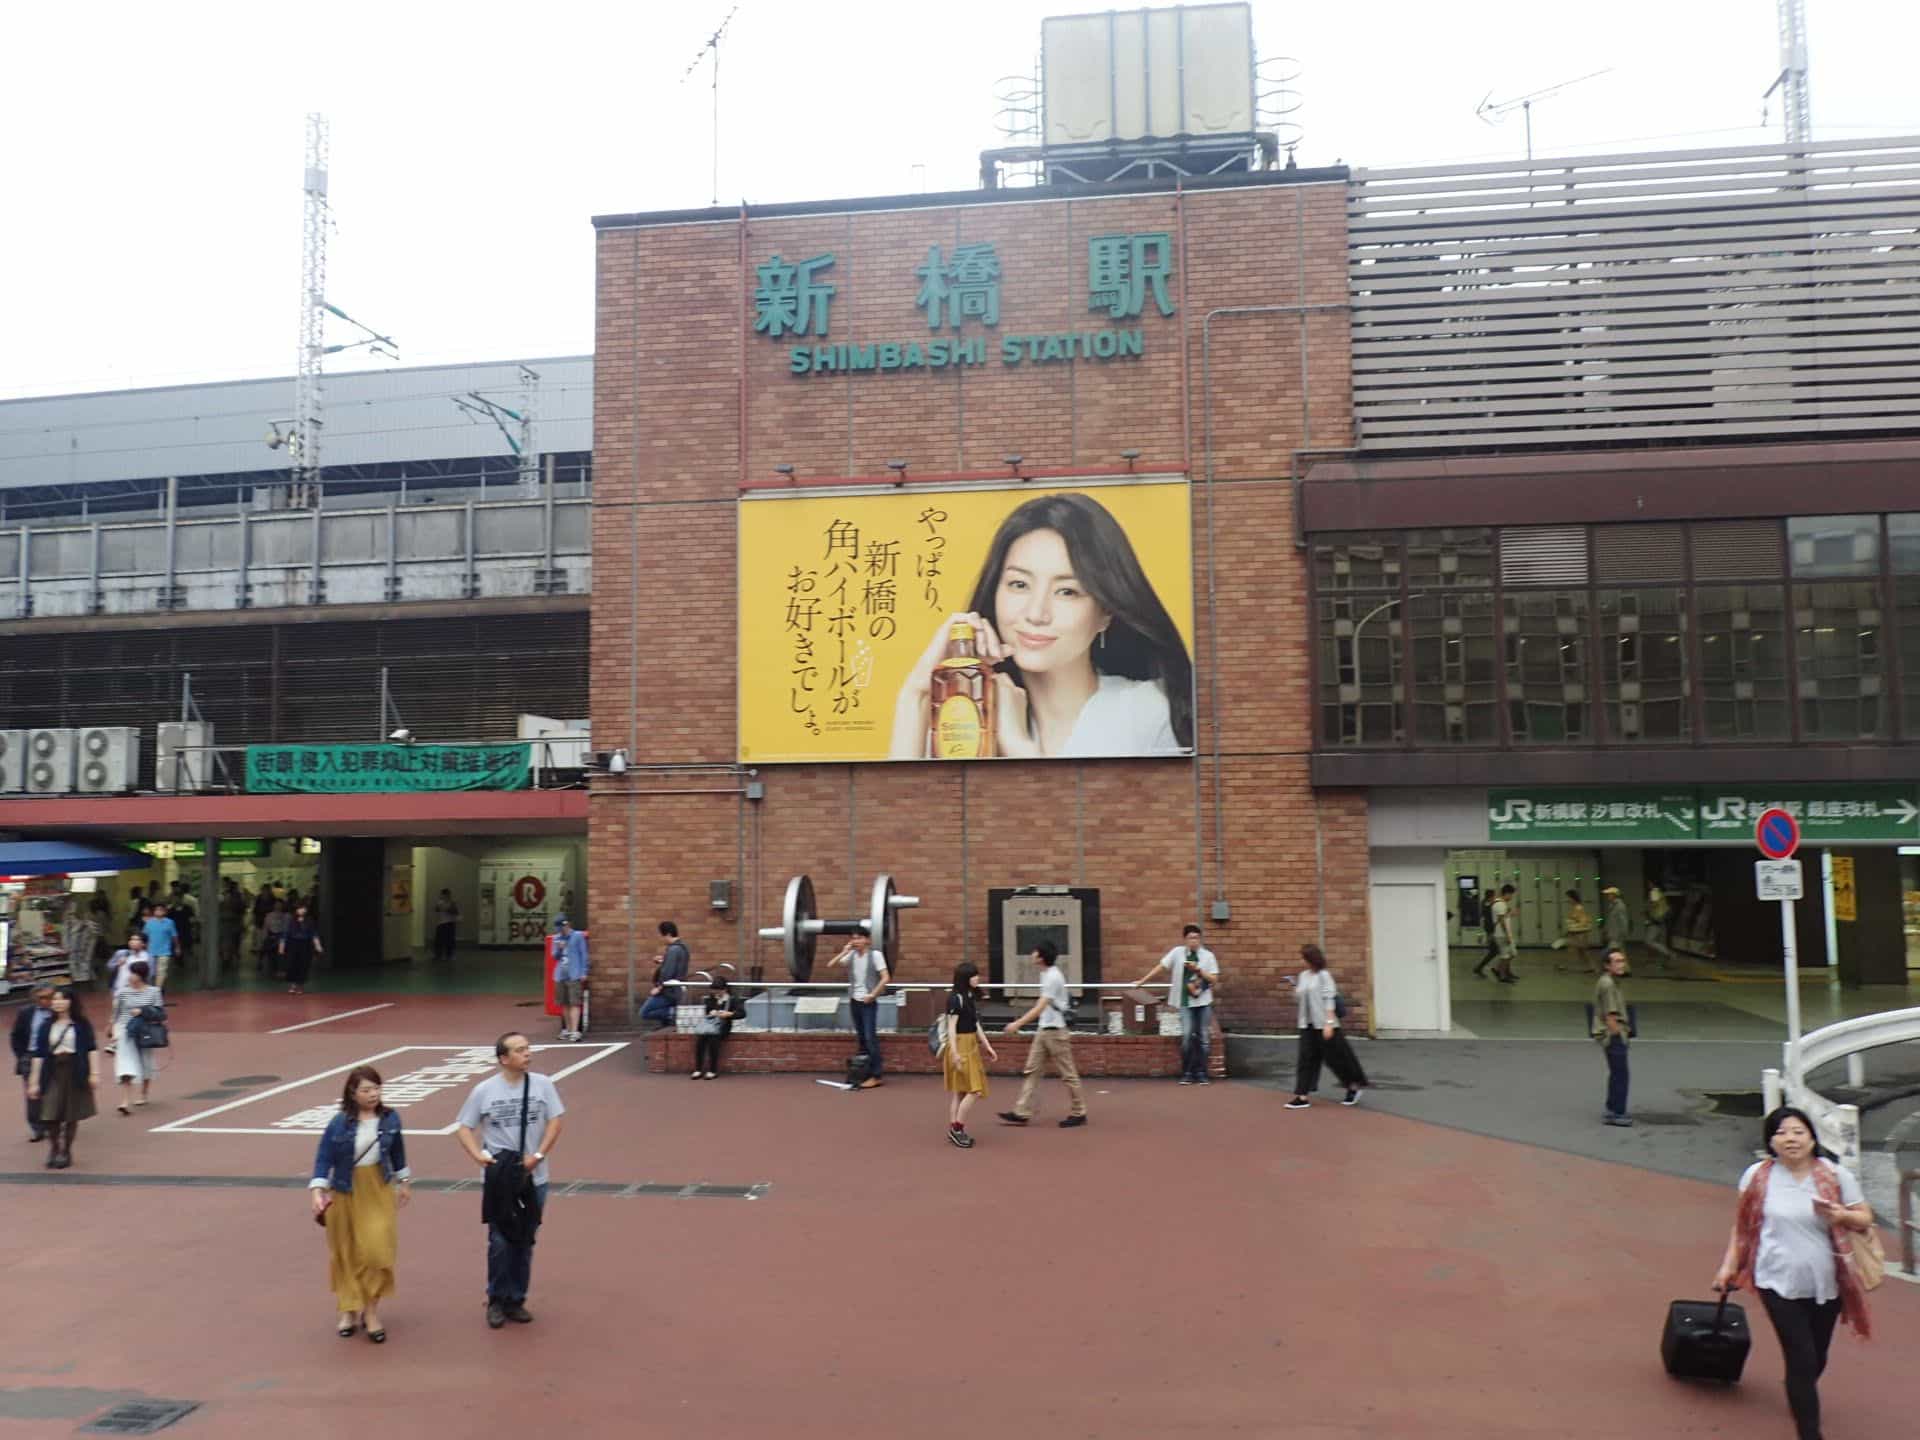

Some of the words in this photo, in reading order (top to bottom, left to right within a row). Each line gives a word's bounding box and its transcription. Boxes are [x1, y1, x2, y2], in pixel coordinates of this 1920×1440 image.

[752, 230, 1176, 338] 新橋駅
[789, 336, 986, 374] SHIMBASHI
[1001, 328, 1144, 364] STATION
[861, 539, 901, 641] 新橋の
[916, 506, 948, 613] やっぱり、
[783, 564, 823, 738] お好きでしょ。
[823, 518, 861, 716] 角ハイボールが
[1489, 799, 1533, 823] JR
[1701, 797, 1747, 820] JR
[509, 921, 546, 939] BOX
